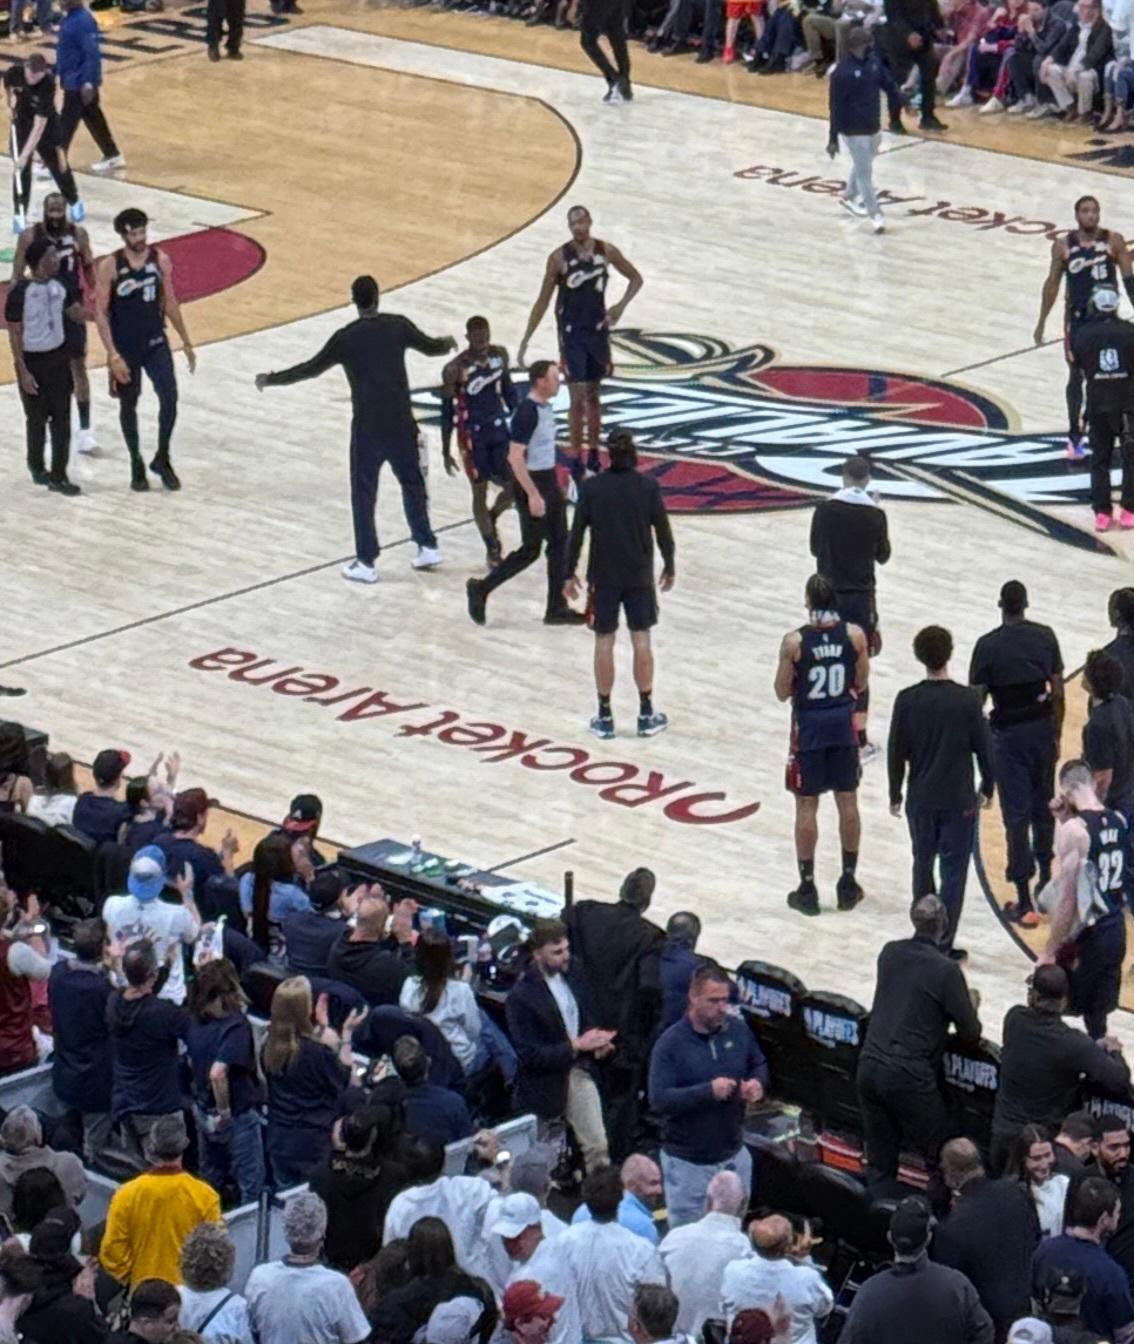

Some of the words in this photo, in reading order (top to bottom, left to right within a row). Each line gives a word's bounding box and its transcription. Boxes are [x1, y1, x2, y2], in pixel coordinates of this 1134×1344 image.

[188, 646, 430, 723] Arena
[808, 663, 845, 700] 20
[394, 710, 697, 809] Rocket
[1099, 850, 1123, 892] 32
[952, 1054, 998, 1090] PLAYOFFS
